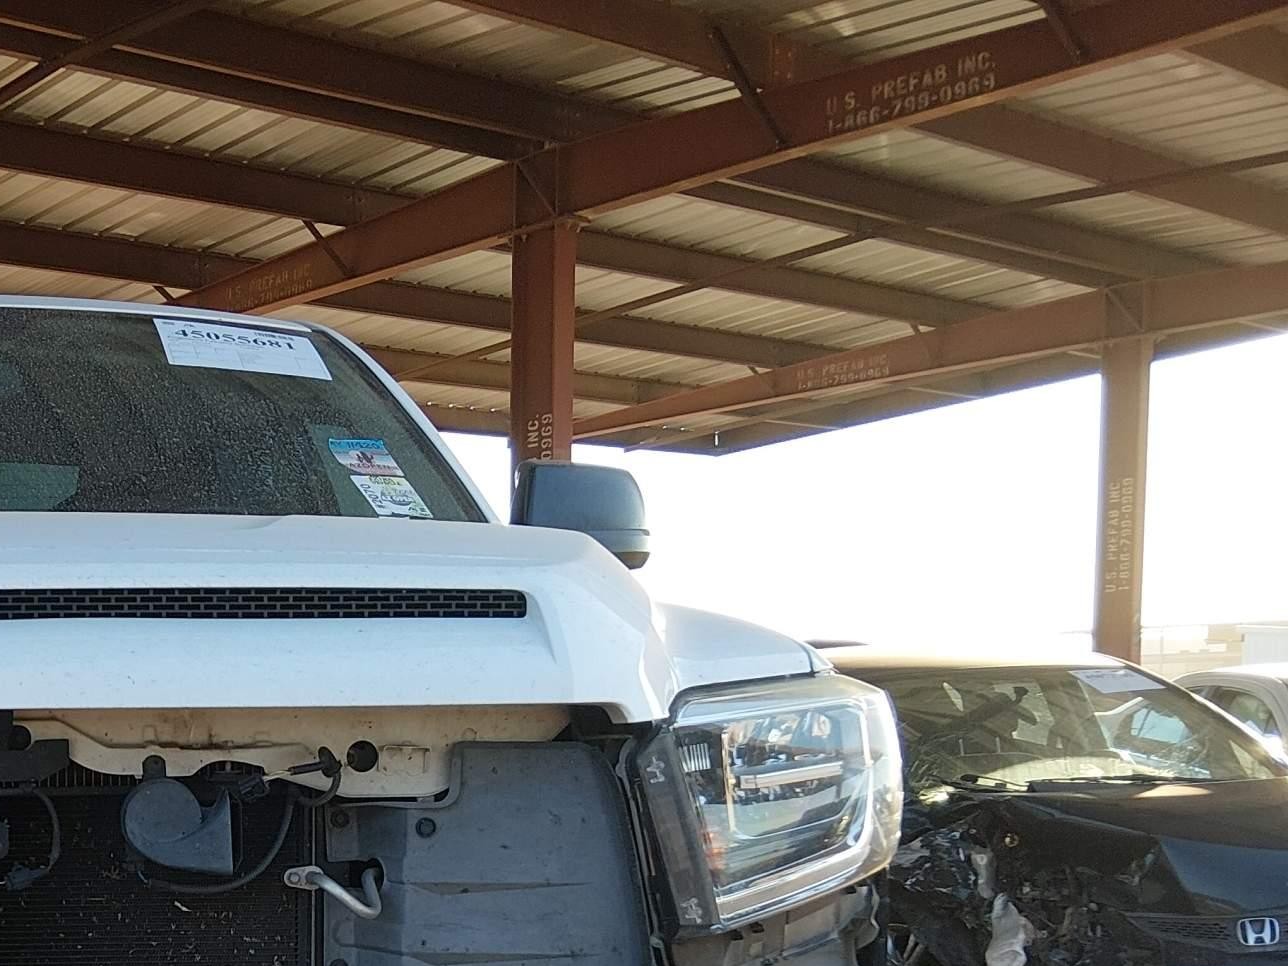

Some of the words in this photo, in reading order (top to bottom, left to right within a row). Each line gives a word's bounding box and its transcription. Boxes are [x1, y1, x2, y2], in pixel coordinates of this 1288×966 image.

[871, 64, 948, 100] PREFAB
[958, 51, 997, 77] INC.
[175, 329, 296, 350] 45055681
[527, 414, 539, 448] INC.
